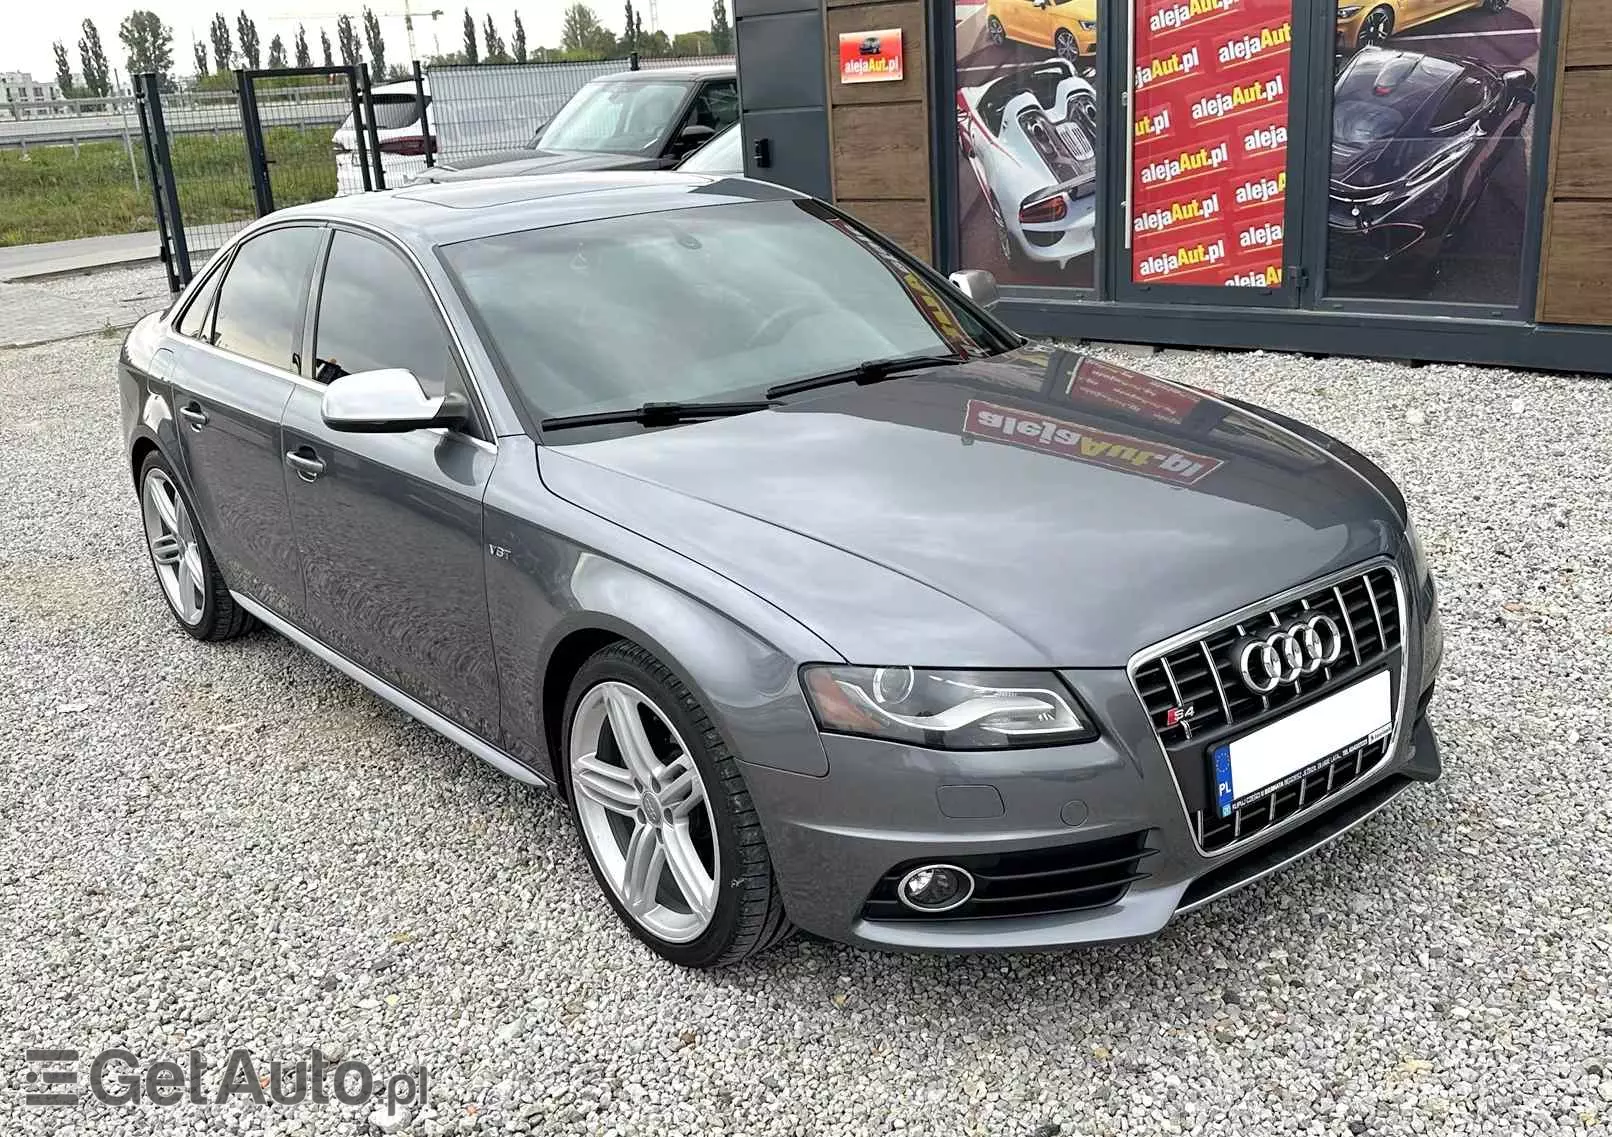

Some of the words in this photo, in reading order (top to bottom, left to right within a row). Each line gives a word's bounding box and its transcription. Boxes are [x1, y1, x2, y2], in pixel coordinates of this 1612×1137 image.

[1150, 0, 1239, 31] alejaAu.p
[1218, 23, 1291, 64] alejaAut
[844, 56, 899, 75] alejaAut.pl
[1191, 75, 1284, 120] alejaAut.pl
[1244, 125, 1287, 151] aleja
[1140, 143, 1228, 184] alejaAut.pl
[1134, 193, 1220, 232] alejaAut.pl
[1139, 240, 1225, 276] alejaAut.pl
[1174, 705, 1196, 721] S4
[1218, 781, 1232, 797] PL
